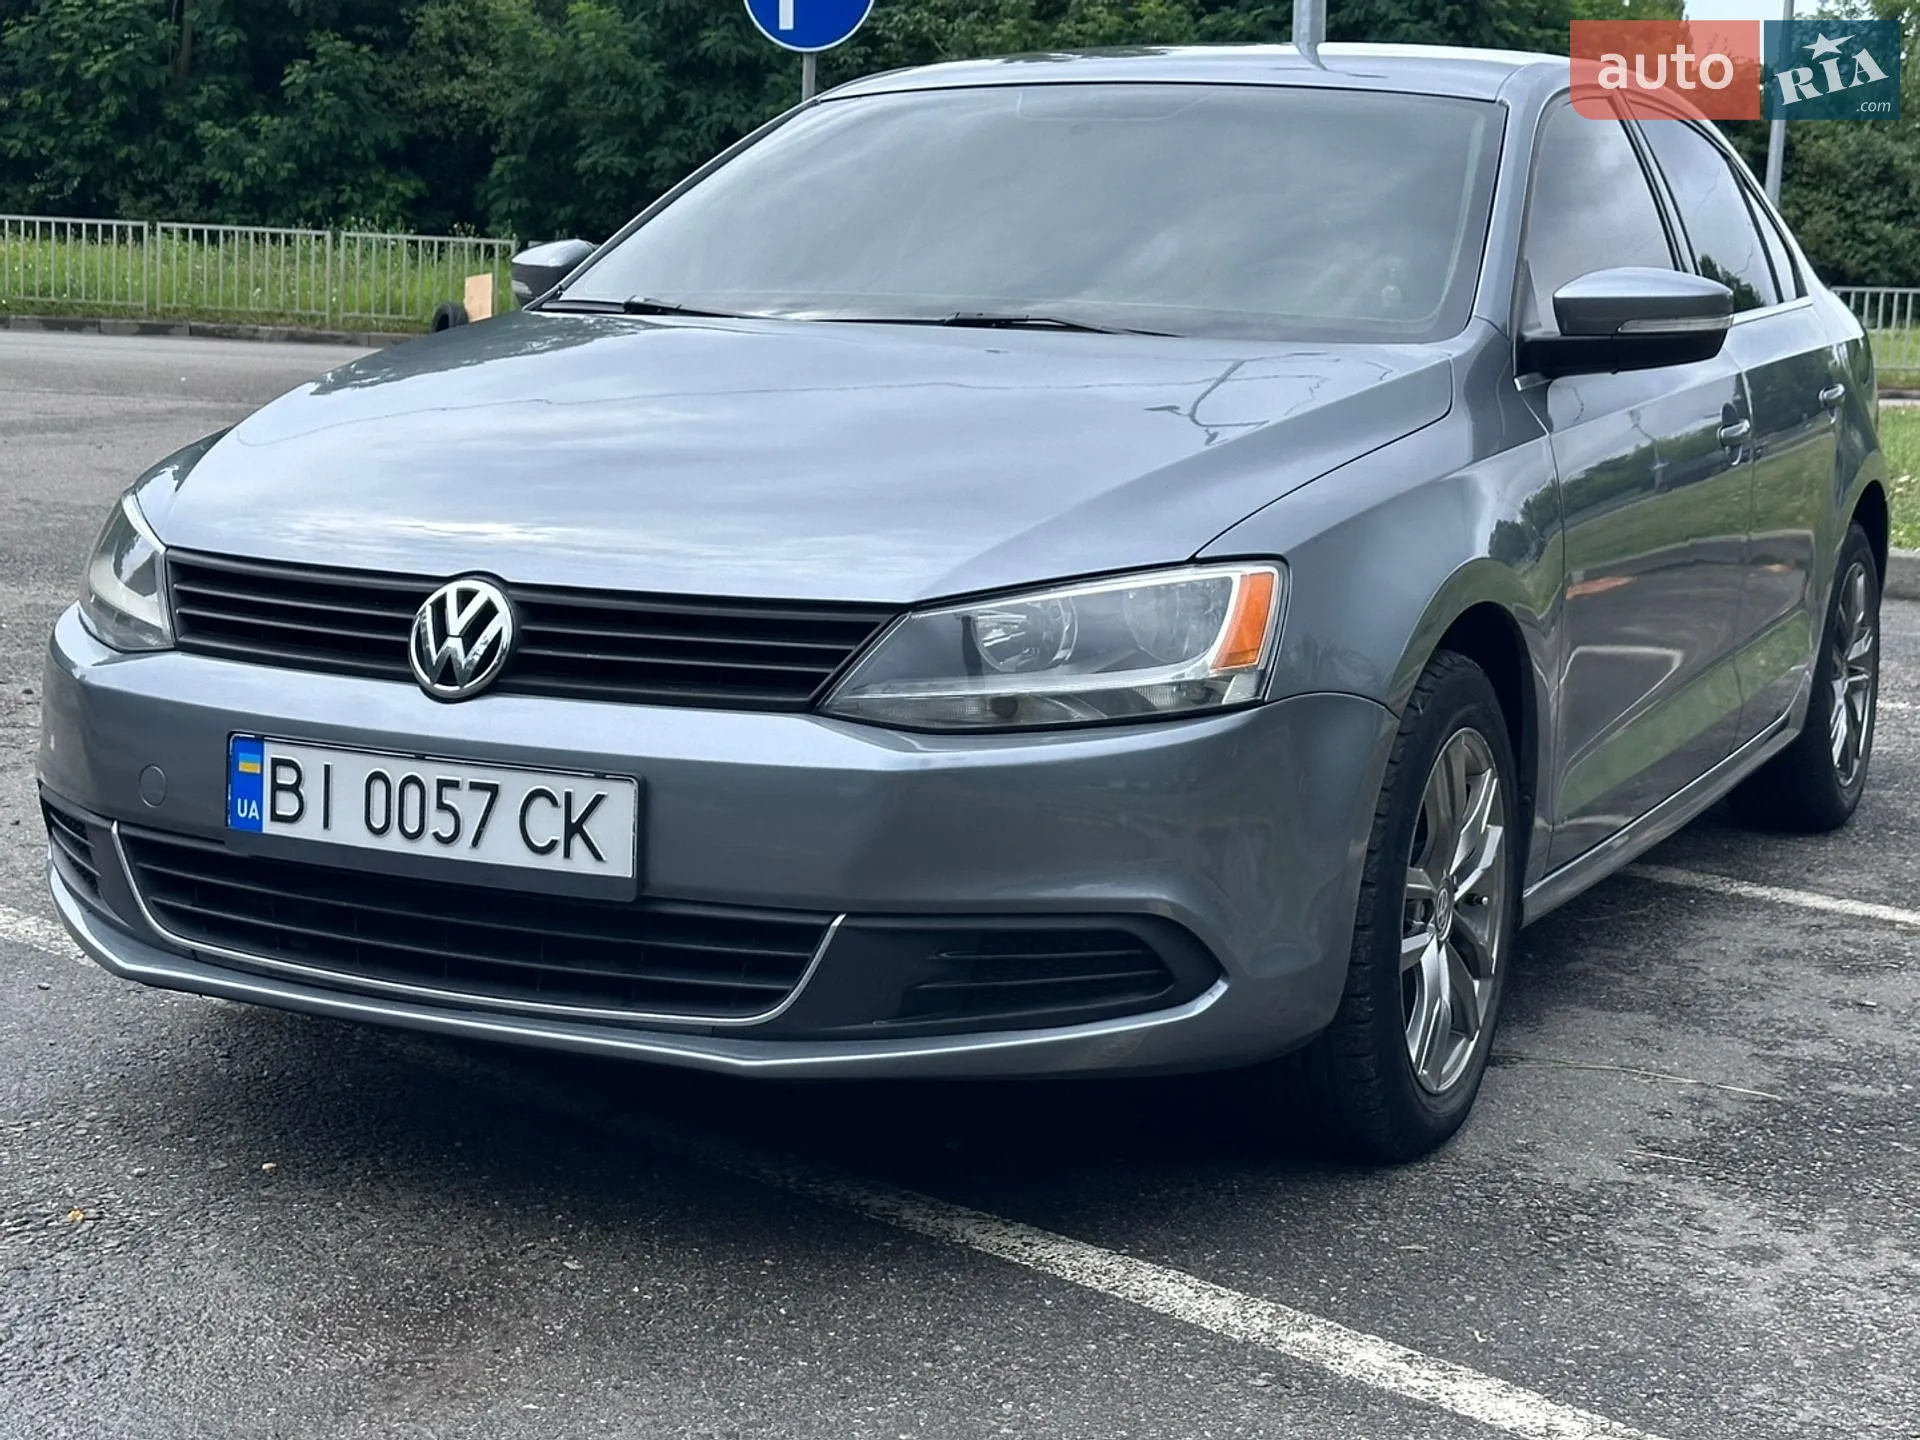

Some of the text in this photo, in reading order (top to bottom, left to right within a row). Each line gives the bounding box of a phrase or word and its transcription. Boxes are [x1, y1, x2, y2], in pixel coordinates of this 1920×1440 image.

[237, 797, 260, 821] UA
[269, 756, 608, 862] BI 0057 CK
